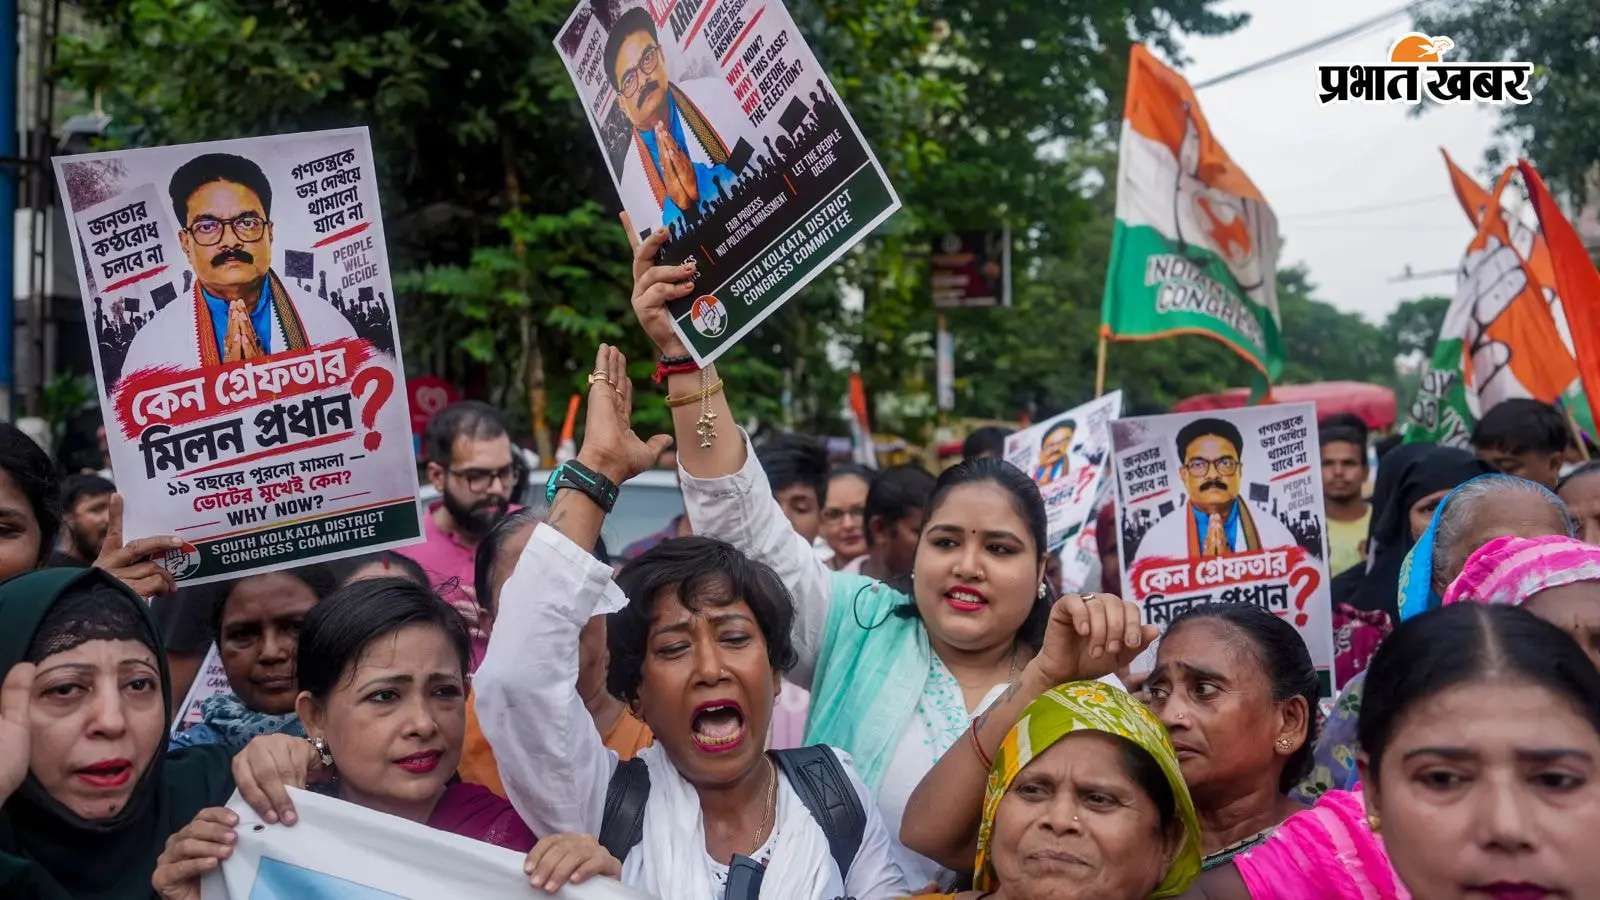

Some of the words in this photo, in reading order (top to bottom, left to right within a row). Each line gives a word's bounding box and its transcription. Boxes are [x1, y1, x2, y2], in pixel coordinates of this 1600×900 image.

[704, 28, 710, 40] A
[708, 17, 730, 50] LEADER
[713, 17, 746, 61] ANSWERS.
[576, 27, 602, 80] DEMOCRACY
[585, 44, 604, 86] CANNOT
[726, 59, 746, 87] WHY
[742, 34, 765, 68] NOW?
[733, 74, 753, 102] WHY
[750, 56, 769, 80] THIS
[765, 29, 789, 64] CASE?
[595, 69, 604, 86] BE
[741, 88, 762, 116] WHY
[758, 57, 789, 95] BEFORE
[748, 105, 768, 129] THE
[764, 59, 804, 111] ELECTION?
[291, 149, 355, 181] গণতন্ত্রকে
[791, 161, 805, 177] LET
[805, 150, 819, 167] THE
[815, 128, 843, 159] PEOPLE
[811, 151, 838, 178] DECIDE
[296, 179, 317, 199] ভয়
[308, 185, 359, 216] থামানো
[88, 201, 149, 236] জনতার
[314, 210, 345, 234] যাবে
[348, 203, 364, 221] না
[715, 242, 729, 257] NOT
[726, 223, 754, 251] POLITICAL
[751, 191, 788, 230] HARASSMENT
[725, 216, 741, 233] FAIR
[737, 196, 764, 225] PROCESS
[92, 221, 160, 258] কণ্ঠরোধ
[333, 236, 373, 264] PEOPLE
[729, 266, 763, 298] SOUTH
[762, 229, 808, 272] KOLKATA
[805, 188, 853, 235] DISTRICT
[101, 252, 144, 279] চলবে
[146, 244, 164, 265] না
[343, 253, 370, 273] WILL
[743, 260, 795, 306] CONGRESS
[794, 210, 853, 264] COMMITTEE
[341, 264, 378, 290] DECIDE
[132, 374, 207, 426] কেন
[214, 348, 349, 406] গ্রেফতার
[139, 417, 244, 479] মিলন
[252, 393, 353, 448] প্রধান
[1268, 440, 1304, 460] থামানো
[167, 481, 190, 497] ১৯
[193, 469, 245, 492] বছরের
[249, 462, 295, 485] পুরনো
[300, 453, 345, 475] মামলা
[1122, 446, 1160, 468] জনতার
[1271, 456, 1293, 472] যাবে
[1295, 451, 1307, 464] না
[193, 484, 253, 513] ভোটের
[259, 476, 304, 505] মুখেই
[309, 469, 352, 492] কেন?
[1129, 479, 1155, 496] চলবে
[1157, 474, 1168, 487] না
[1283, 475, 1312, 494] PEOPLE
[1288, 494, 1314, 511] DECIDE
[227, 502, 267, 527] WHY
[274, 495, 324, 518] NOW?
[211, 535, 257, 556] SOUTH
[259, 524, 319, 546] KOLKATA
[325, 511, 385, 533] DISTRICT
[221, 542, 294, 565] CONGRESS
[298, 526, 377, 551] COMMITTEE
[1140, 563, 1191, 593] কেন
[1195, 550, 1290, 587] গ্রেফতার
